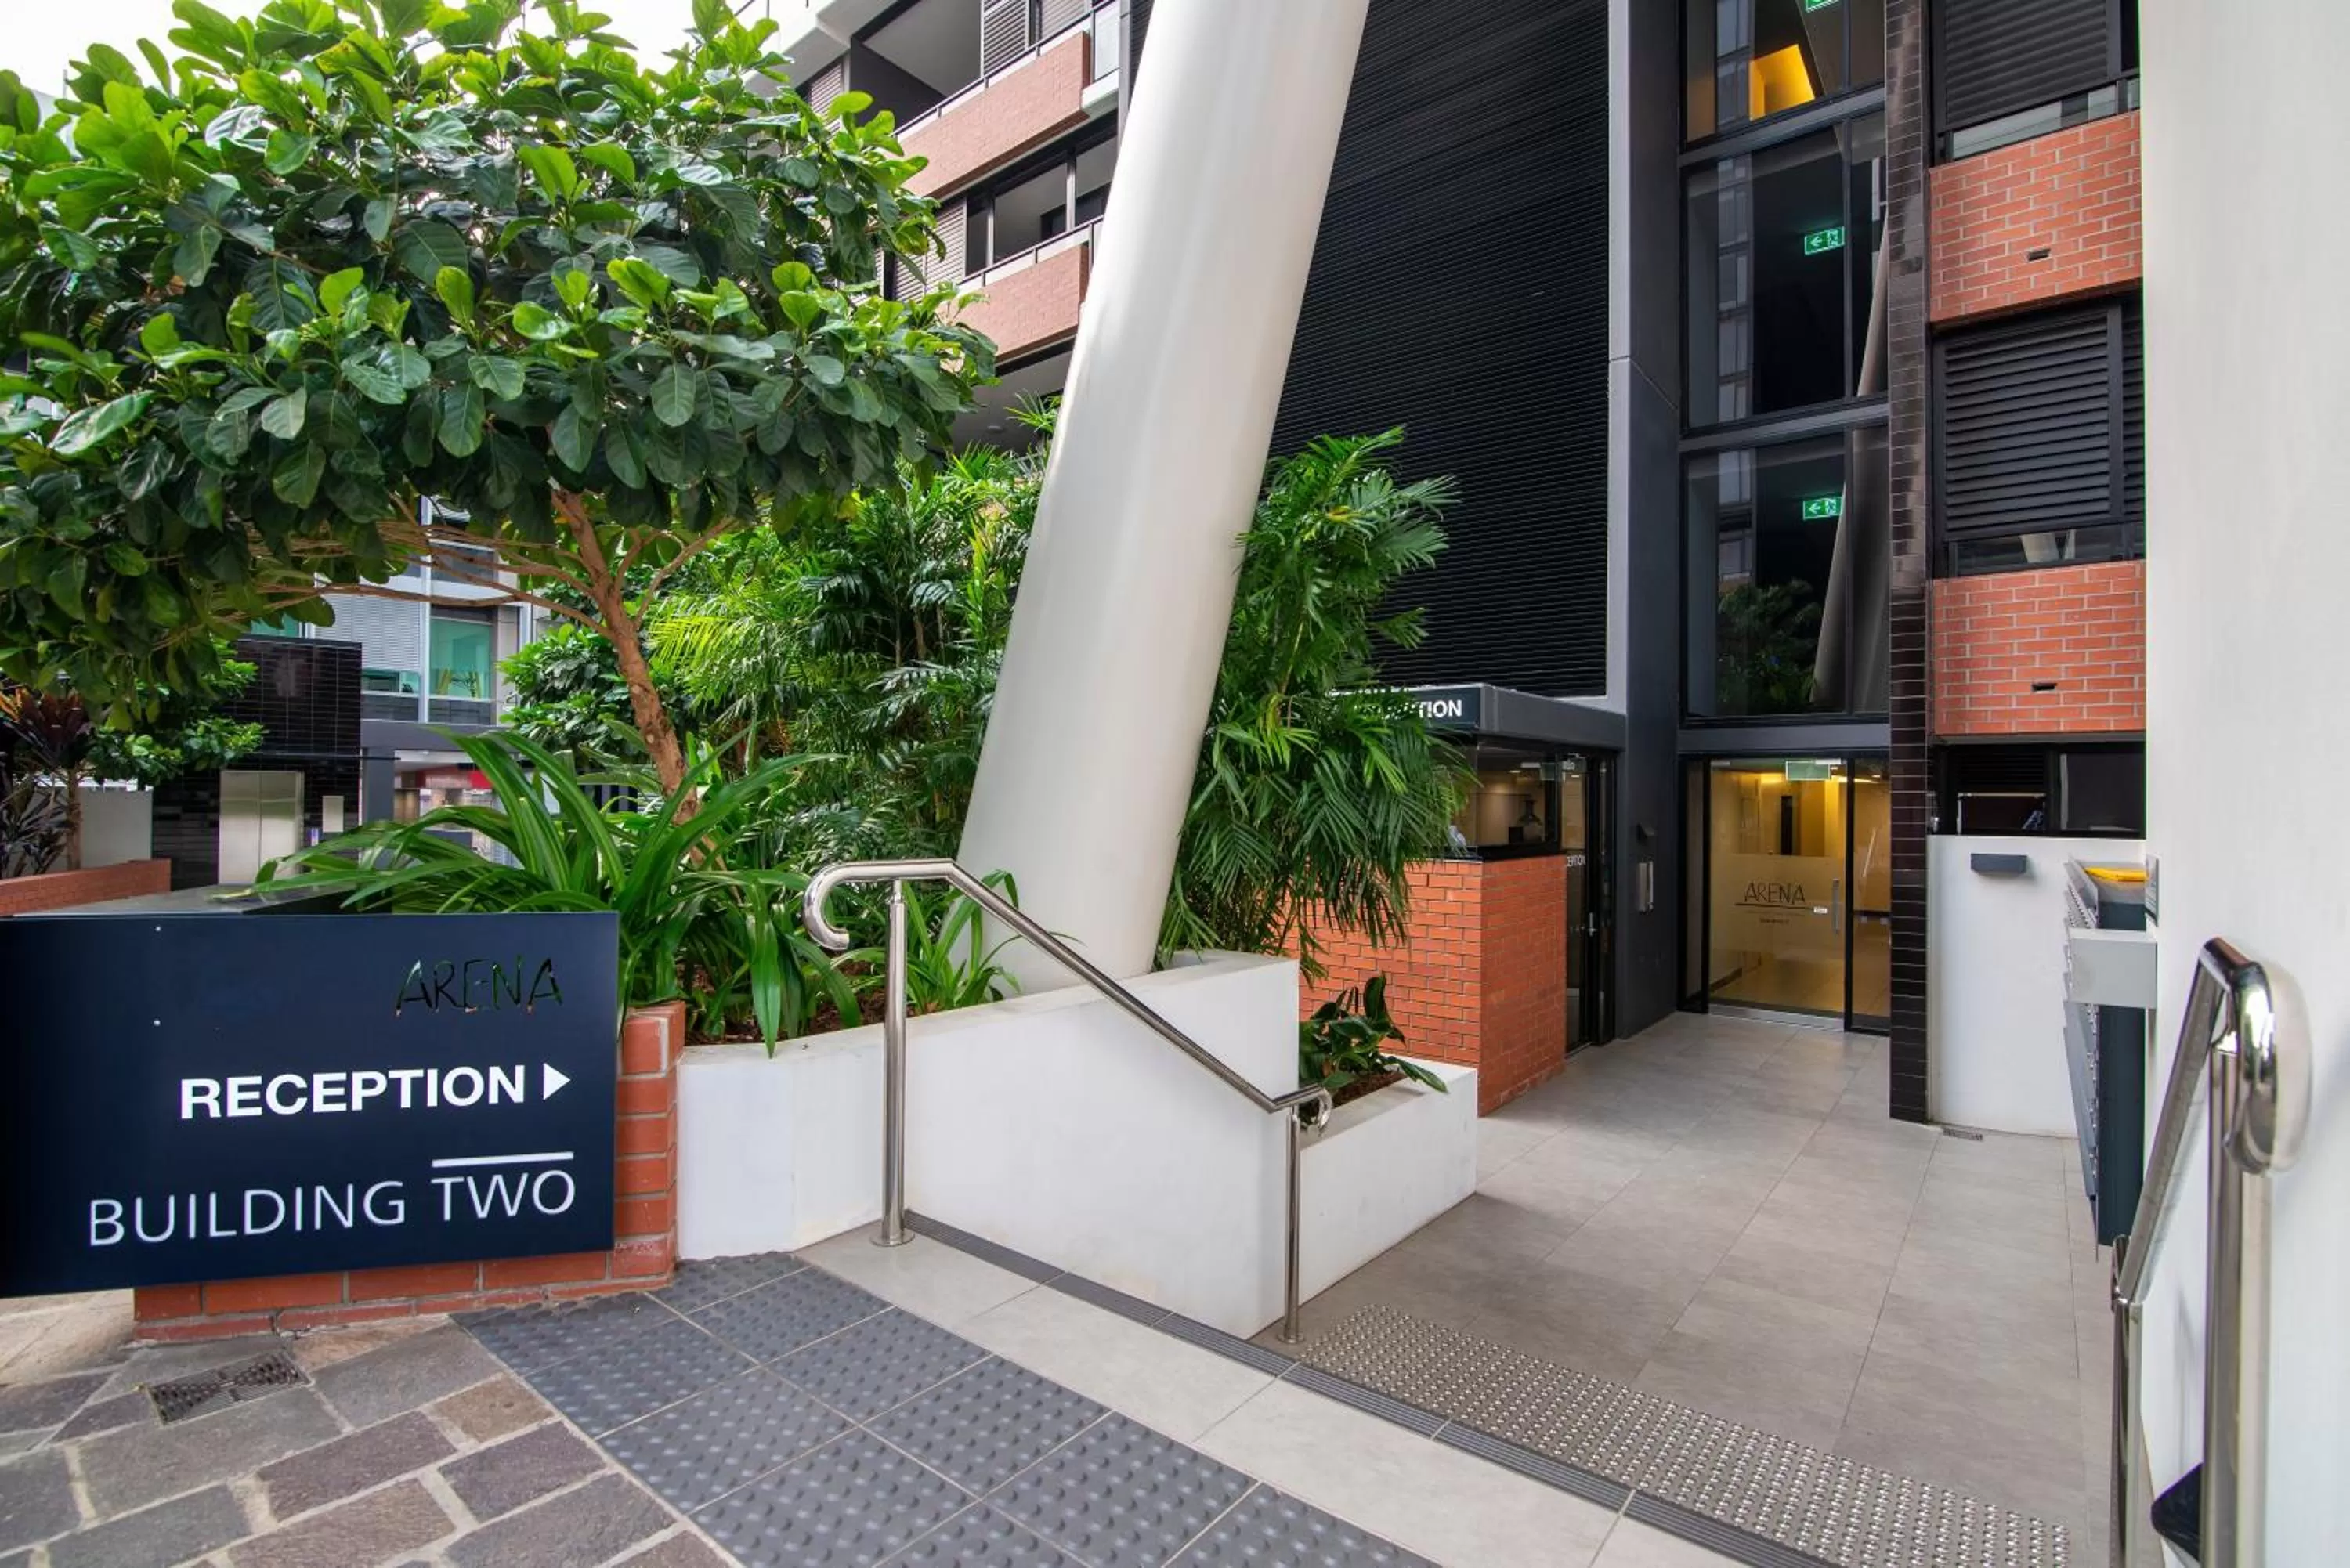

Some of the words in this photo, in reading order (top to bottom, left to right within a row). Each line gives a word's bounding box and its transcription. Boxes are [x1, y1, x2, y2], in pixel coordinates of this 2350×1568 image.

[1744, 882, 1806, 905] ARENA
[395, 954, 563, 1017] ARENA
[181, 1064, 525, 1119] RECEPTION
[90, 1180, 406, 1247] BUILDING
[431, 1169, 576, 1222] TWO
